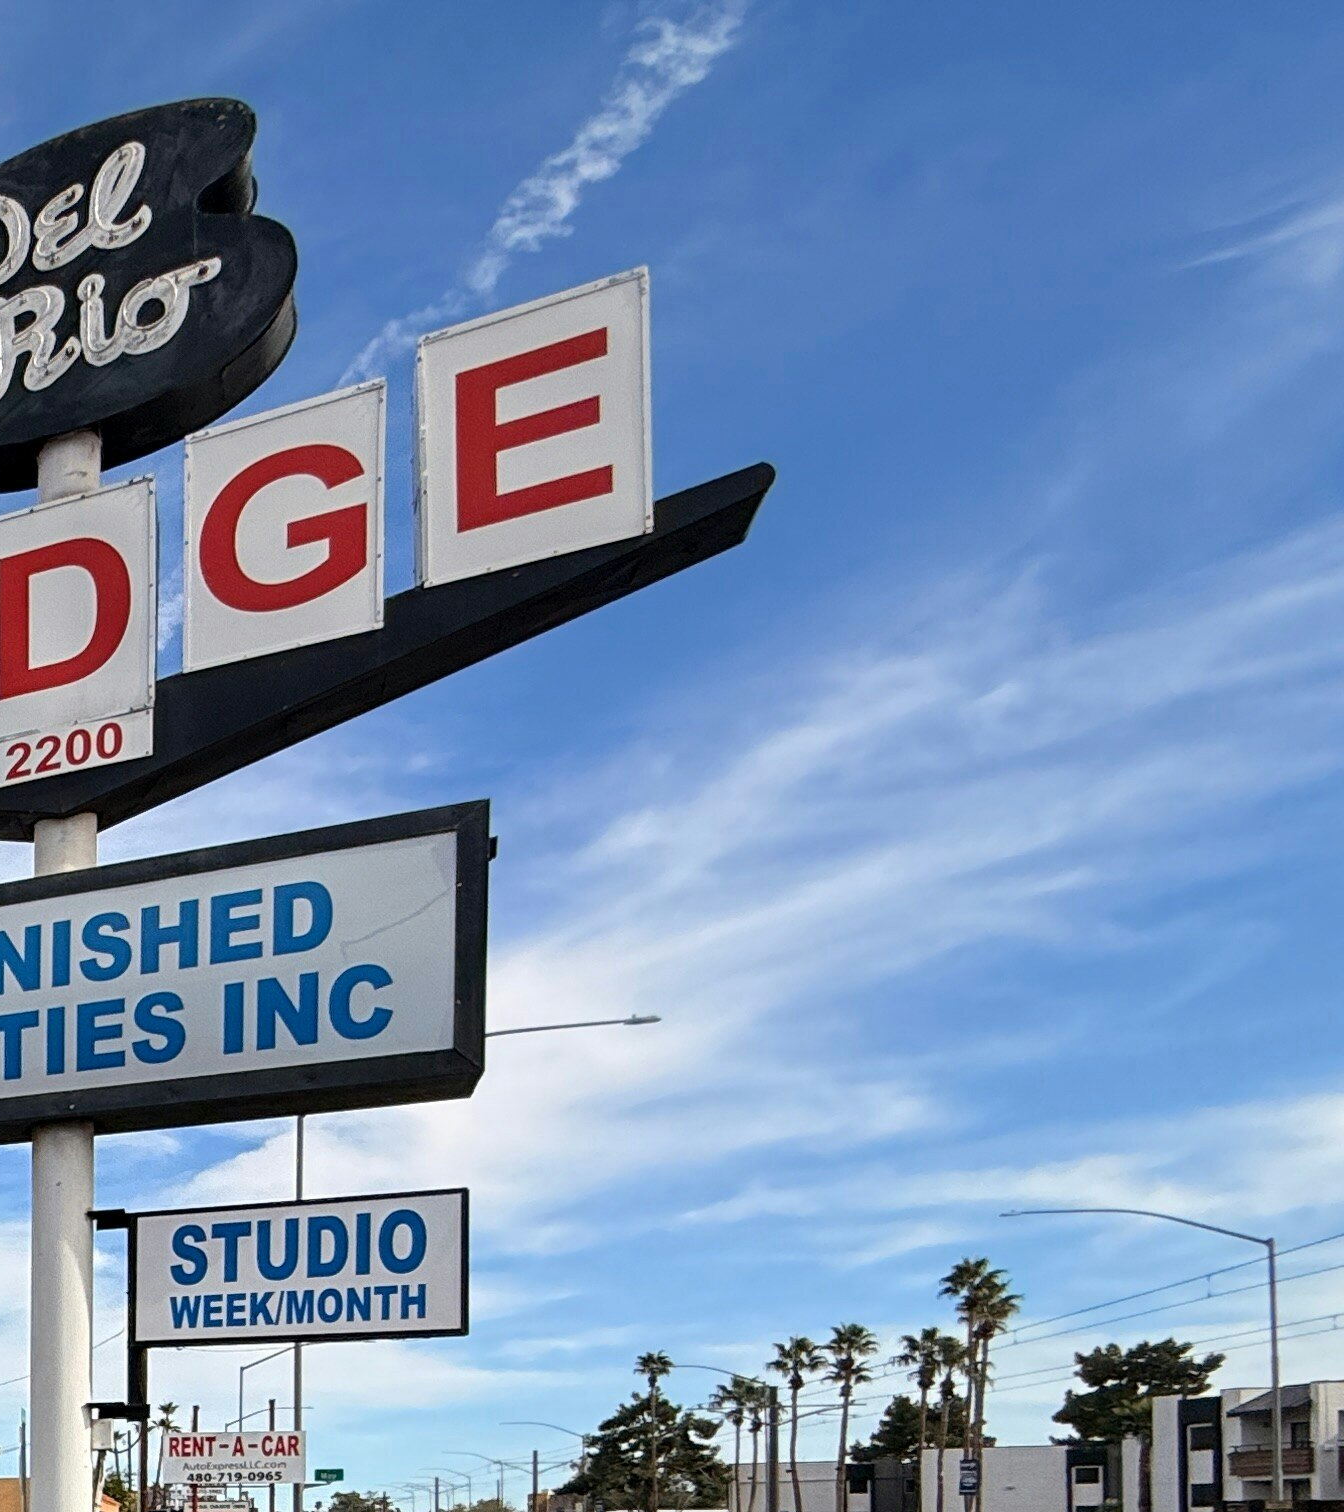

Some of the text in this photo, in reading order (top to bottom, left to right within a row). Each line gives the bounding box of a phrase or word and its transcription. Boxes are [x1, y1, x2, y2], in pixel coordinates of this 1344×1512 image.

[6, 722, 123, 780] 2200
[222, 963, 394, 1055] INC
[170, 1209, 427, 1286] STUDIO
[170, 1284, 427, 1330] WEEK/MONTH
[182, 1461, 287, 1473] AutoExpressLLC.com
[186, 1471, 283, 1483] 480-719-0965
